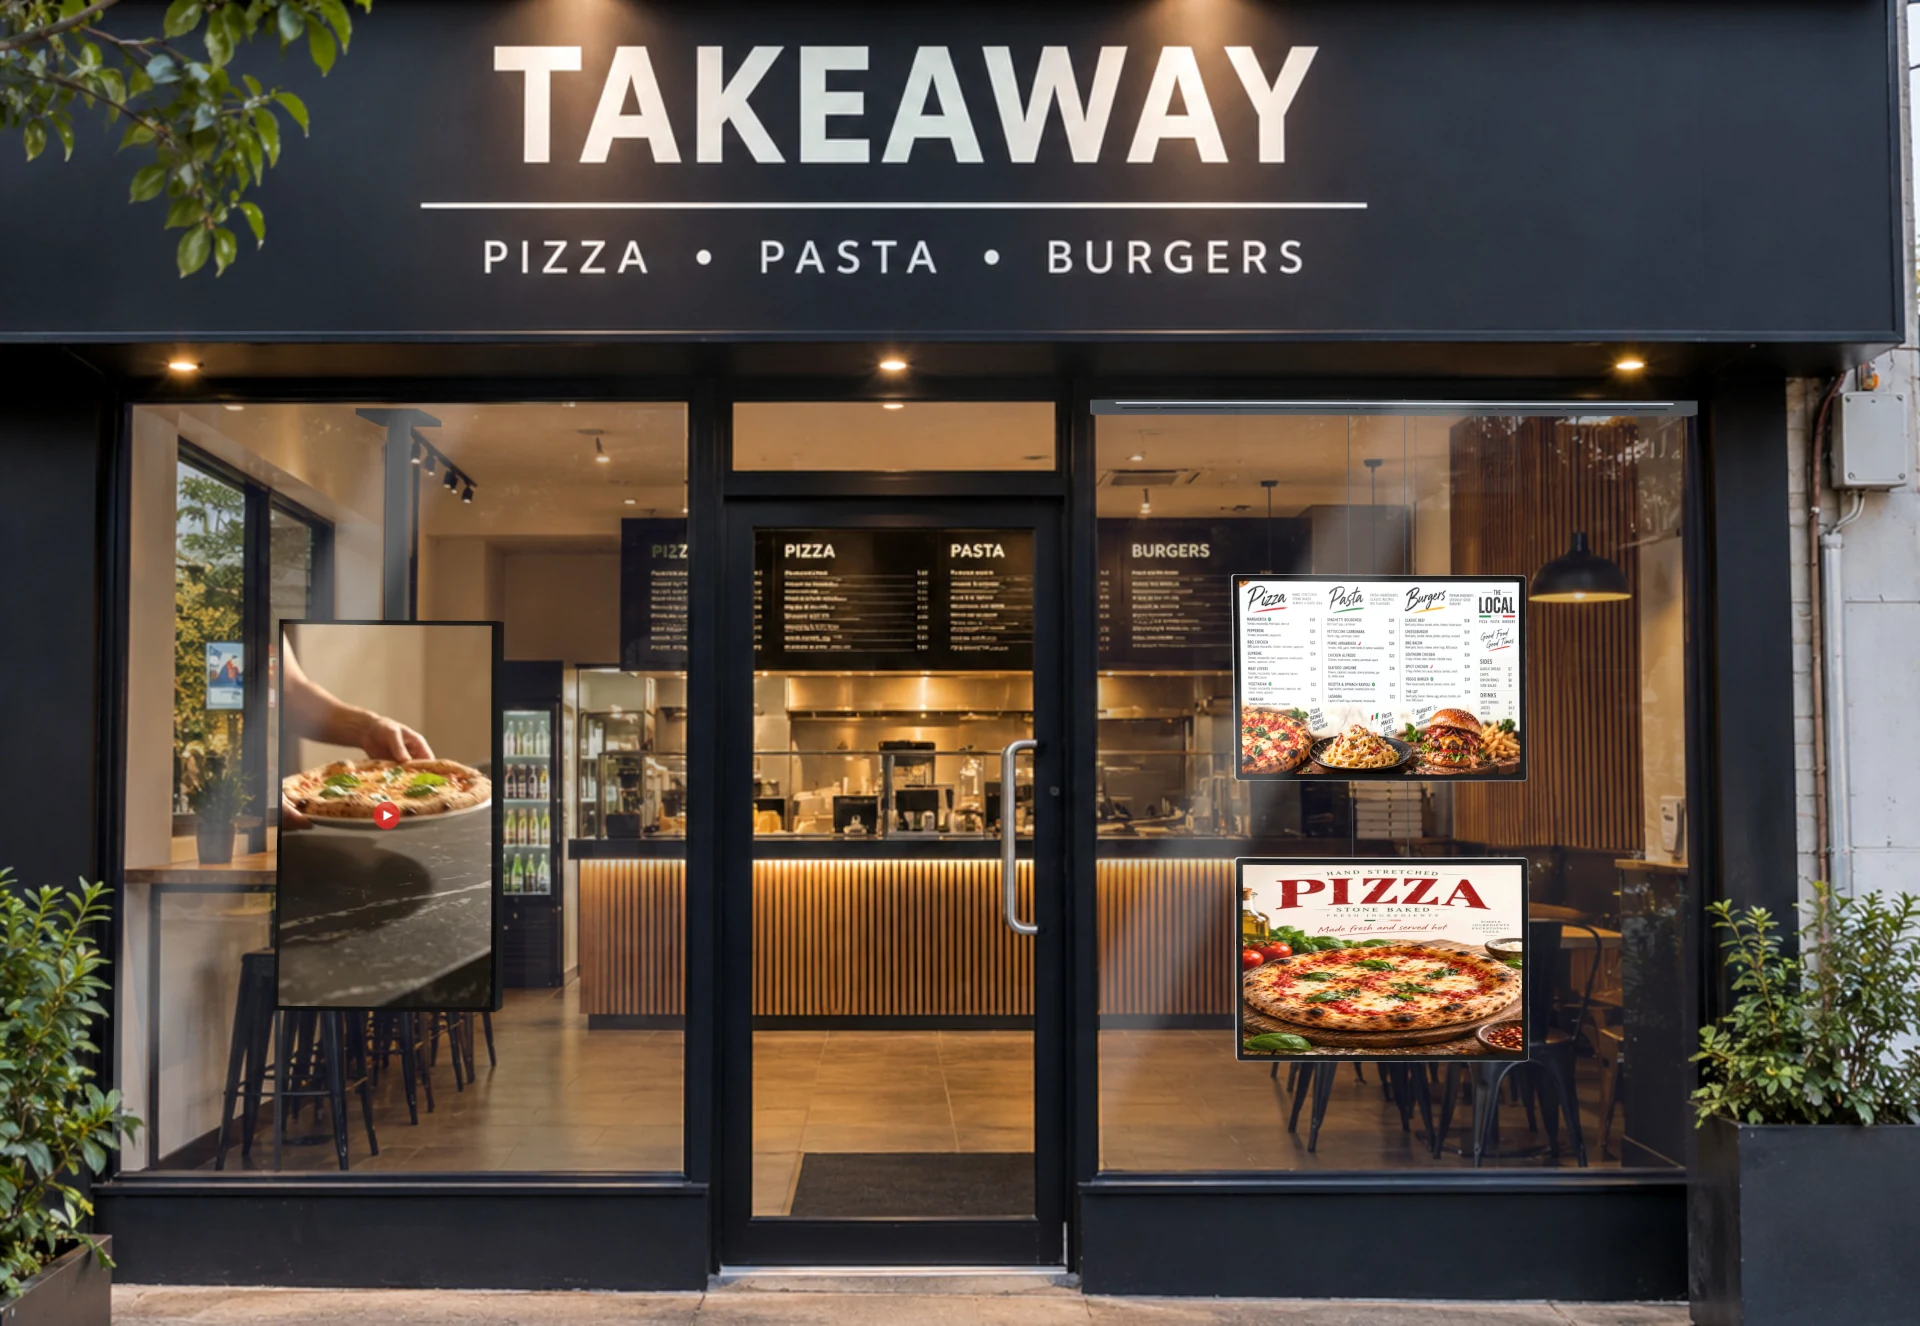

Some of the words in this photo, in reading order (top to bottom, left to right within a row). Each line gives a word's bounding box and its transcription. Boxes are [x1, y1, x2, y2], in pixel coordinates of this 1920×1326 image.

[493, 45, 1318, 164] TAKEAWAY
[484, 239, 648, 275] PIZZA
[761, 239, 937, 275] PASTA
[1048, 239, 1303, 275] BURGERS
[784, 544, 836, 559] PIZZA
[950, 544, 1006, 558] PASTA
[1131, 544, 1210, 558] BURGERS
[1247, 585, 1288, 612] Pizza
[1328, 585, 1364, 611] Pasta
[1404, 586, 1447, 612] Burgers
[1478, 596, 1516, 614] LOCAL
[1480, 630, 1496, 642] Good
[1496, 628, 1510, 639] Food
[1486, 639, 1500, 649] Good
[1275, 877, 1492, 911] PIZZA
[1316, 926, 1346, 934] Made
[1349, 924, 1373, 933] fresh
[1399, 923, 1430, 931] served
